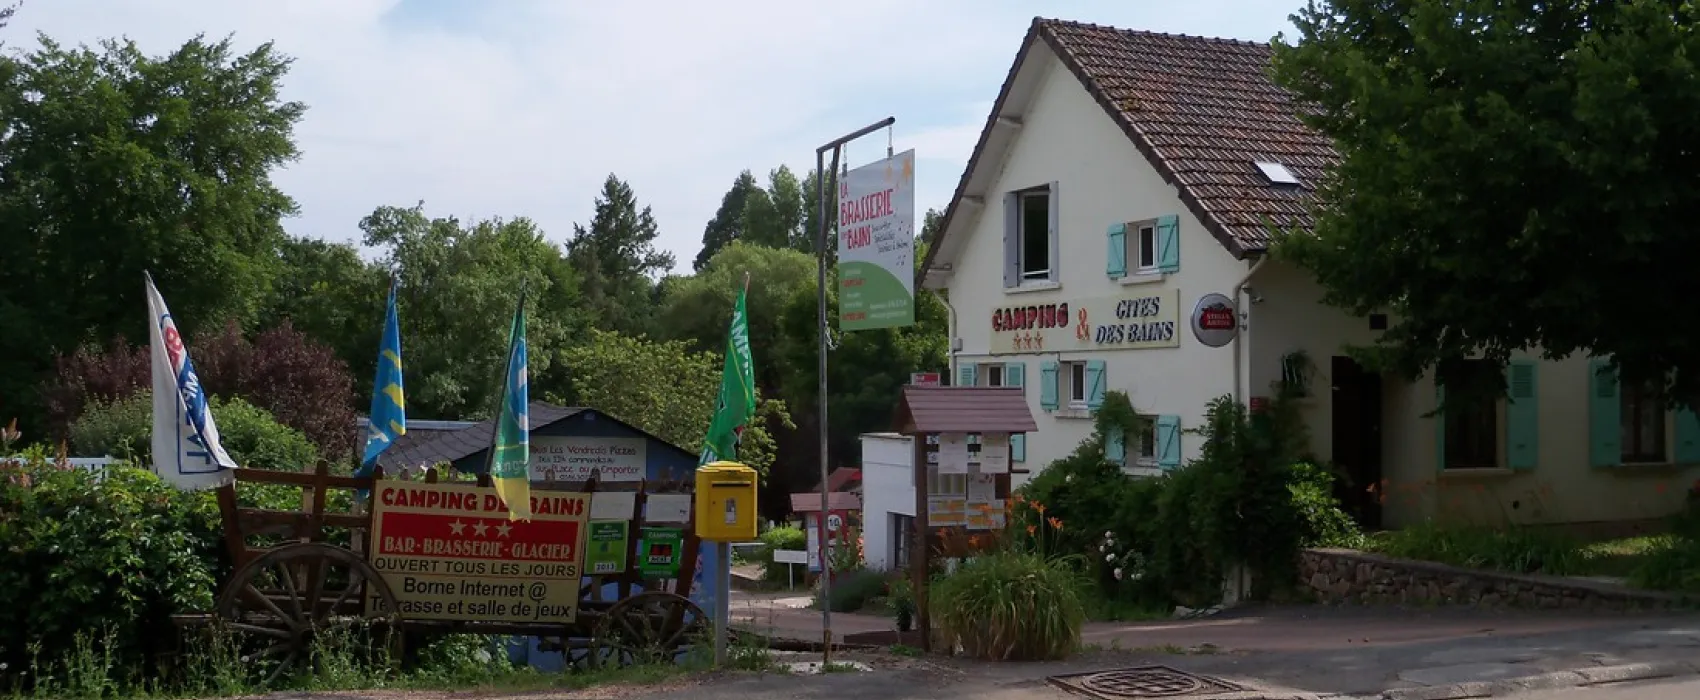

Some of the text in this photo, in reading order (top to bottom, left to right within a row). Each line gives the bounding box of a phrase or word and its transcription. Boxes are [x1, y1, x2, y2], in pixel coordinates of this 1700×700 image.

[841, 188, 893, 226] BRASSERIE
[848, 224, 870, 249] BAINS
[992, 302, 1069, 332] CAMPING
[1116, 297, 1160, 320] GITES
[1096, 321, 1174, 344] DES BAINS
[382, 488, 477, 511] CAMPING
[384, 536, 571, 559] BAR BRASSERIE GLACIER
[375, 558, 576, 577] OUVERT TOUS LES JOURS
[404, 577, 546, 601] Borne Internet @
[447, 600, 463, 614] et
[467, 600, 508, 616] salle
[511, 601, 531, 616] de
[534, 601, 570, 620] jeux
